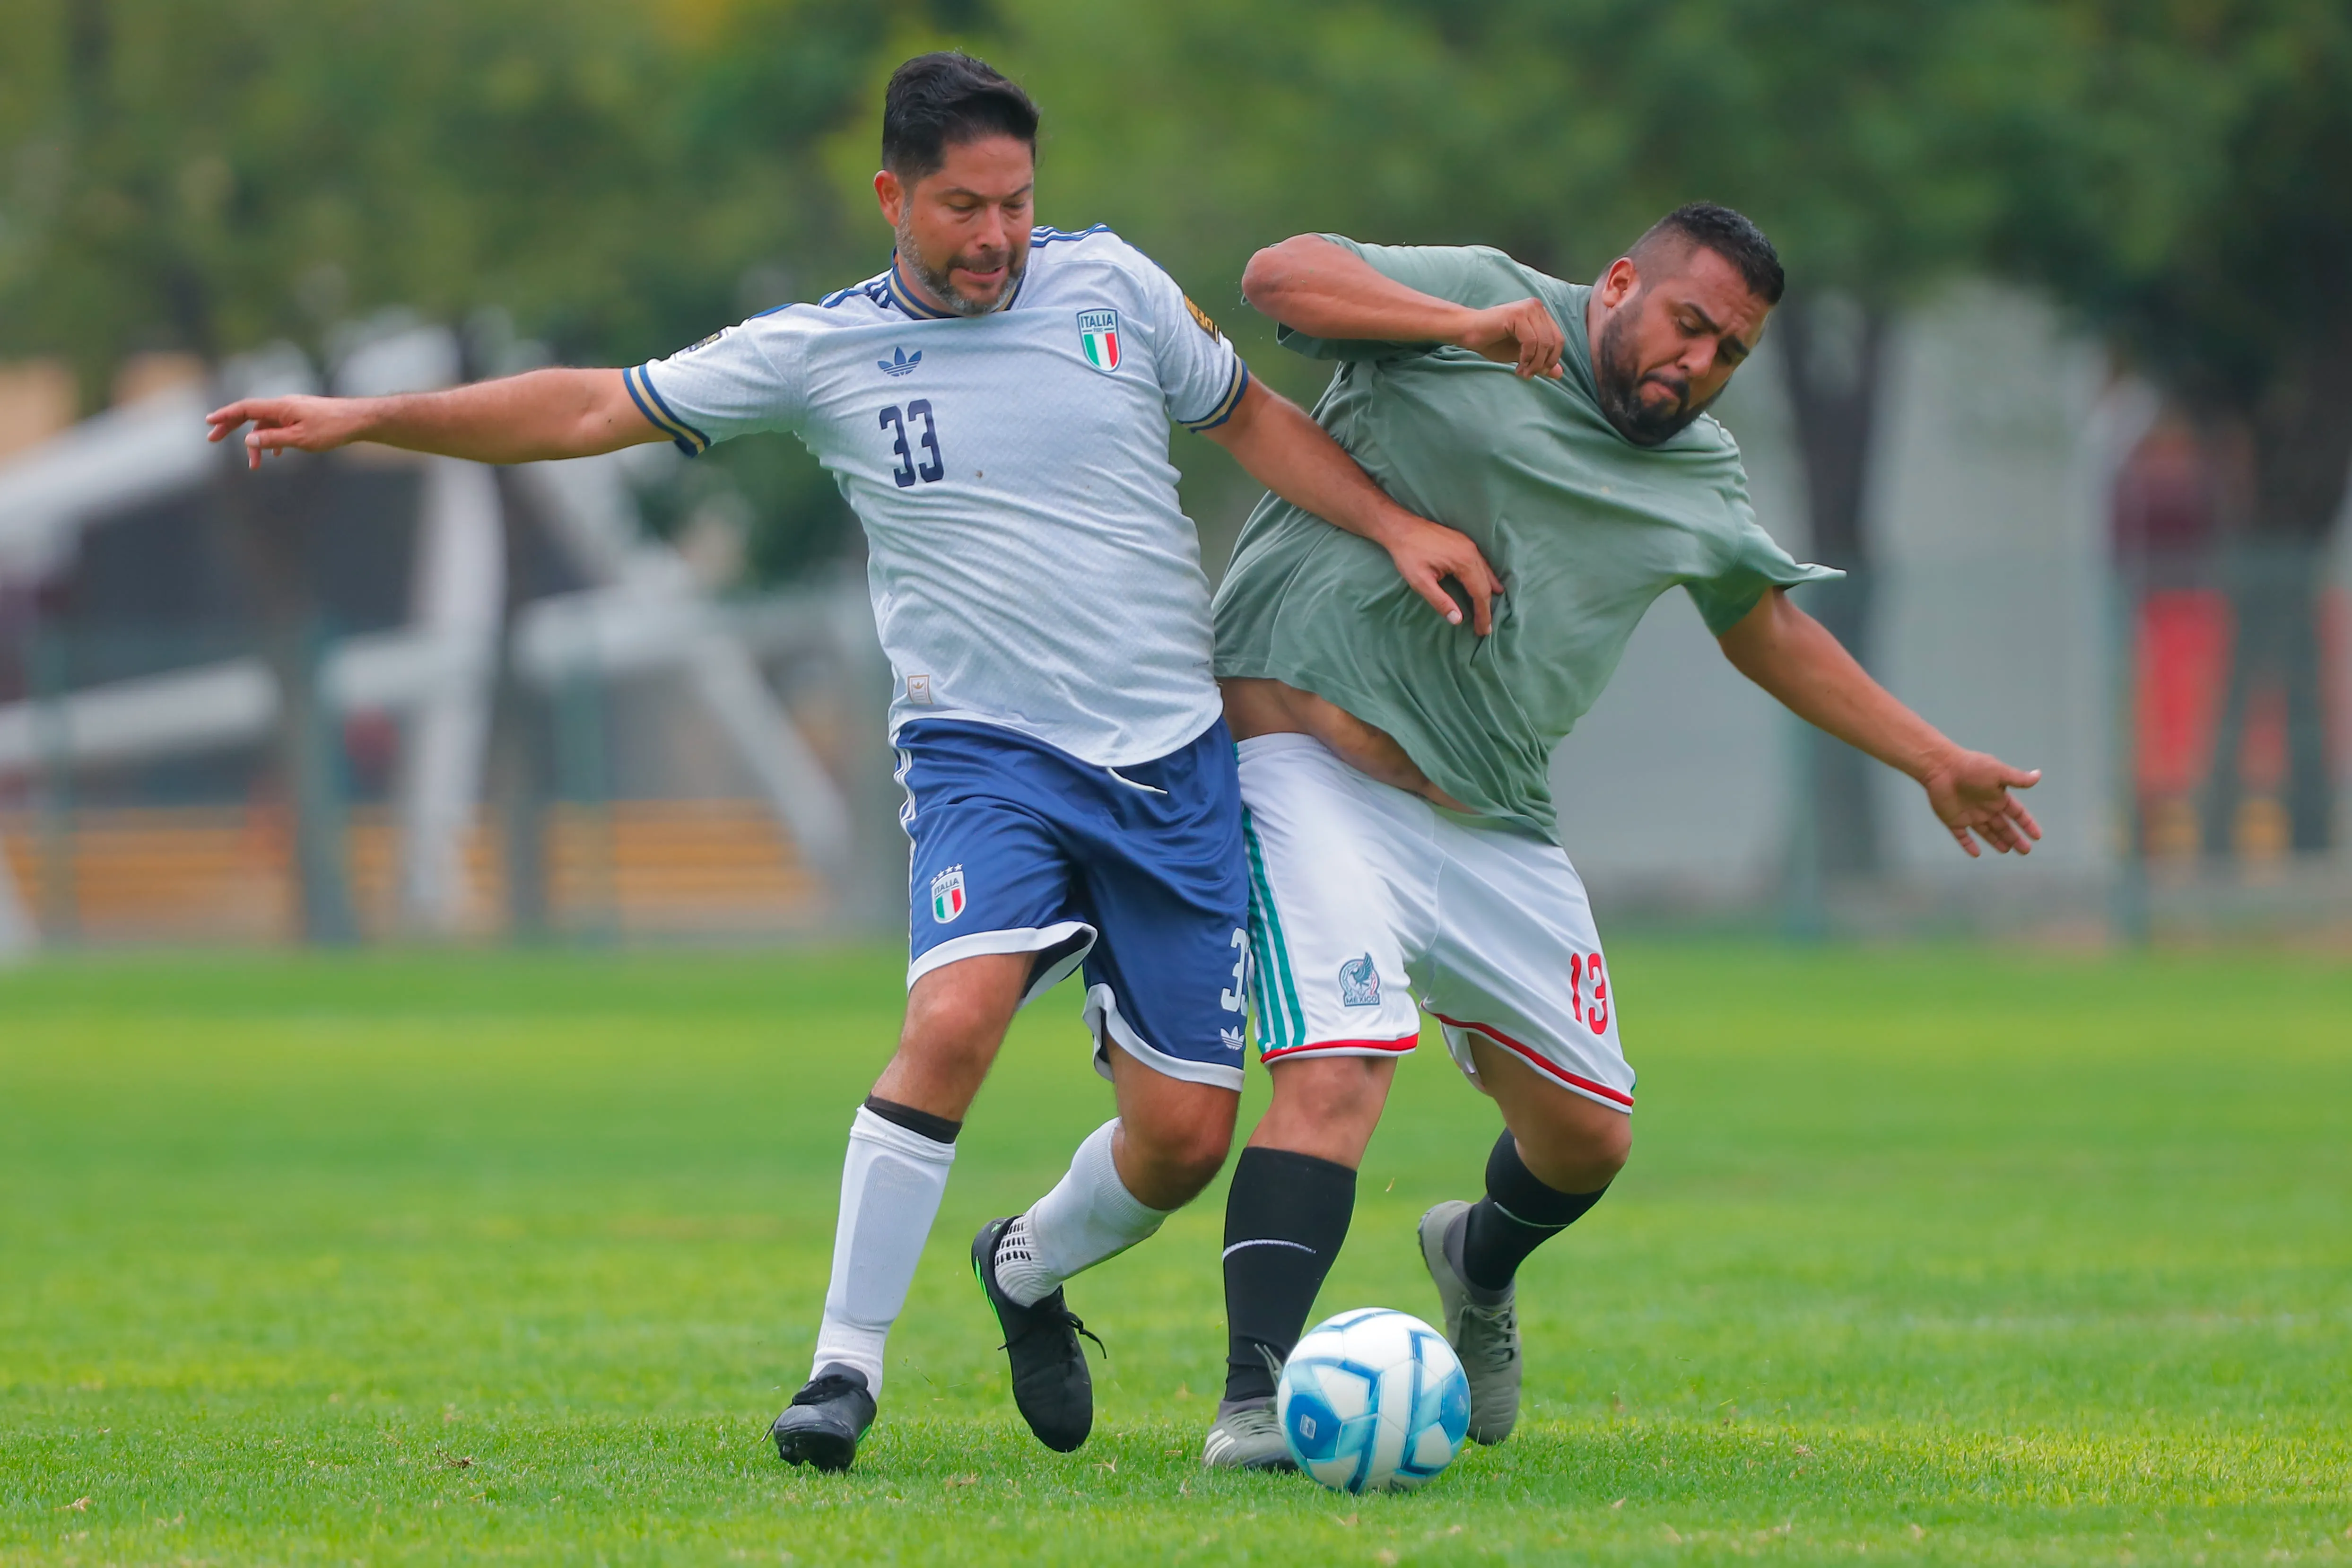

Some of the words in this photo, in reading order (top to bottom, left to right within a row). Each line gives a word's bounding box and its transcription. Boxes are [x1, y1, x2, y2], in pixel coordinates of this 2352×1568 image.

[1080, 314, 1114, 328] ITALIA
[880, 399, 944, 488] 33
[934, 878, 959, 895] ITALIA
[1220, 927, 1251, 1017] 3
[1571, 953, 1607, 1035] 13
